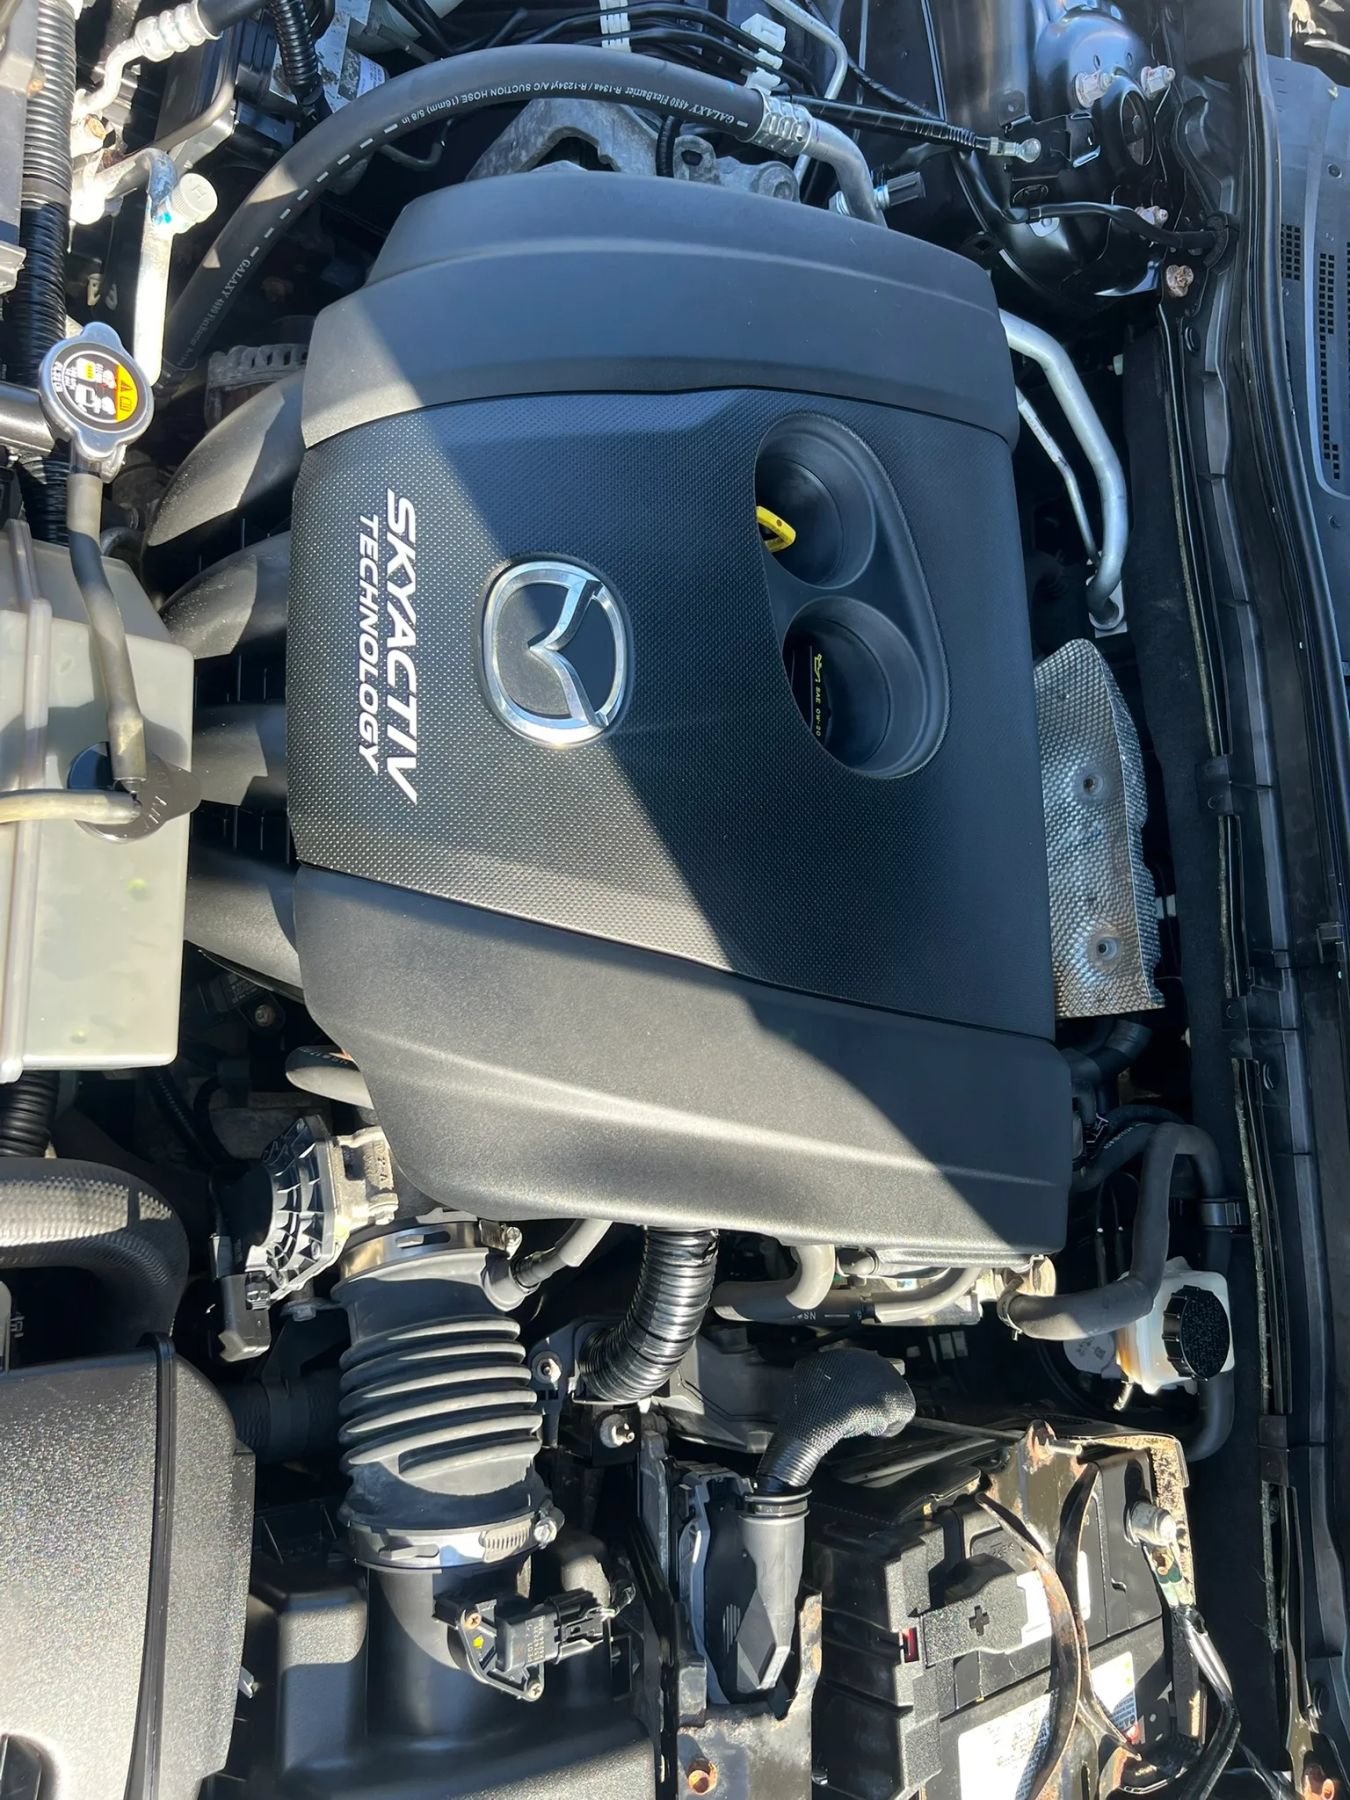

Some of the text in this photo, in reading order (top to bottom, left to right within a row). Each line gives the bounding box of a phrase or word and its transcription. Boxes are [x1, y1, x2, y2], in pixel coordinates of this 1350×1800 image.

[490, 83, 532, 97] SUCTION
[533, 81, 550, 91] A/C
[551, 80, 588, 91] R-1234yf
[594, 82, 623, 94] R-134a
[461, 90, 488, 104] HOSE
[624, 86, 670, 105] FlexBarrier
[426, 95, 459, 114] (16mm)
[411, 108, 425, 120] 5/8
[689, 103, 736, 124] GALAXY
[221, 259, 251, 298] GALAXY
[358, 514, 379, 776] TECHNOLOGY
[386, 487, 418, 806] SKYACTIV
